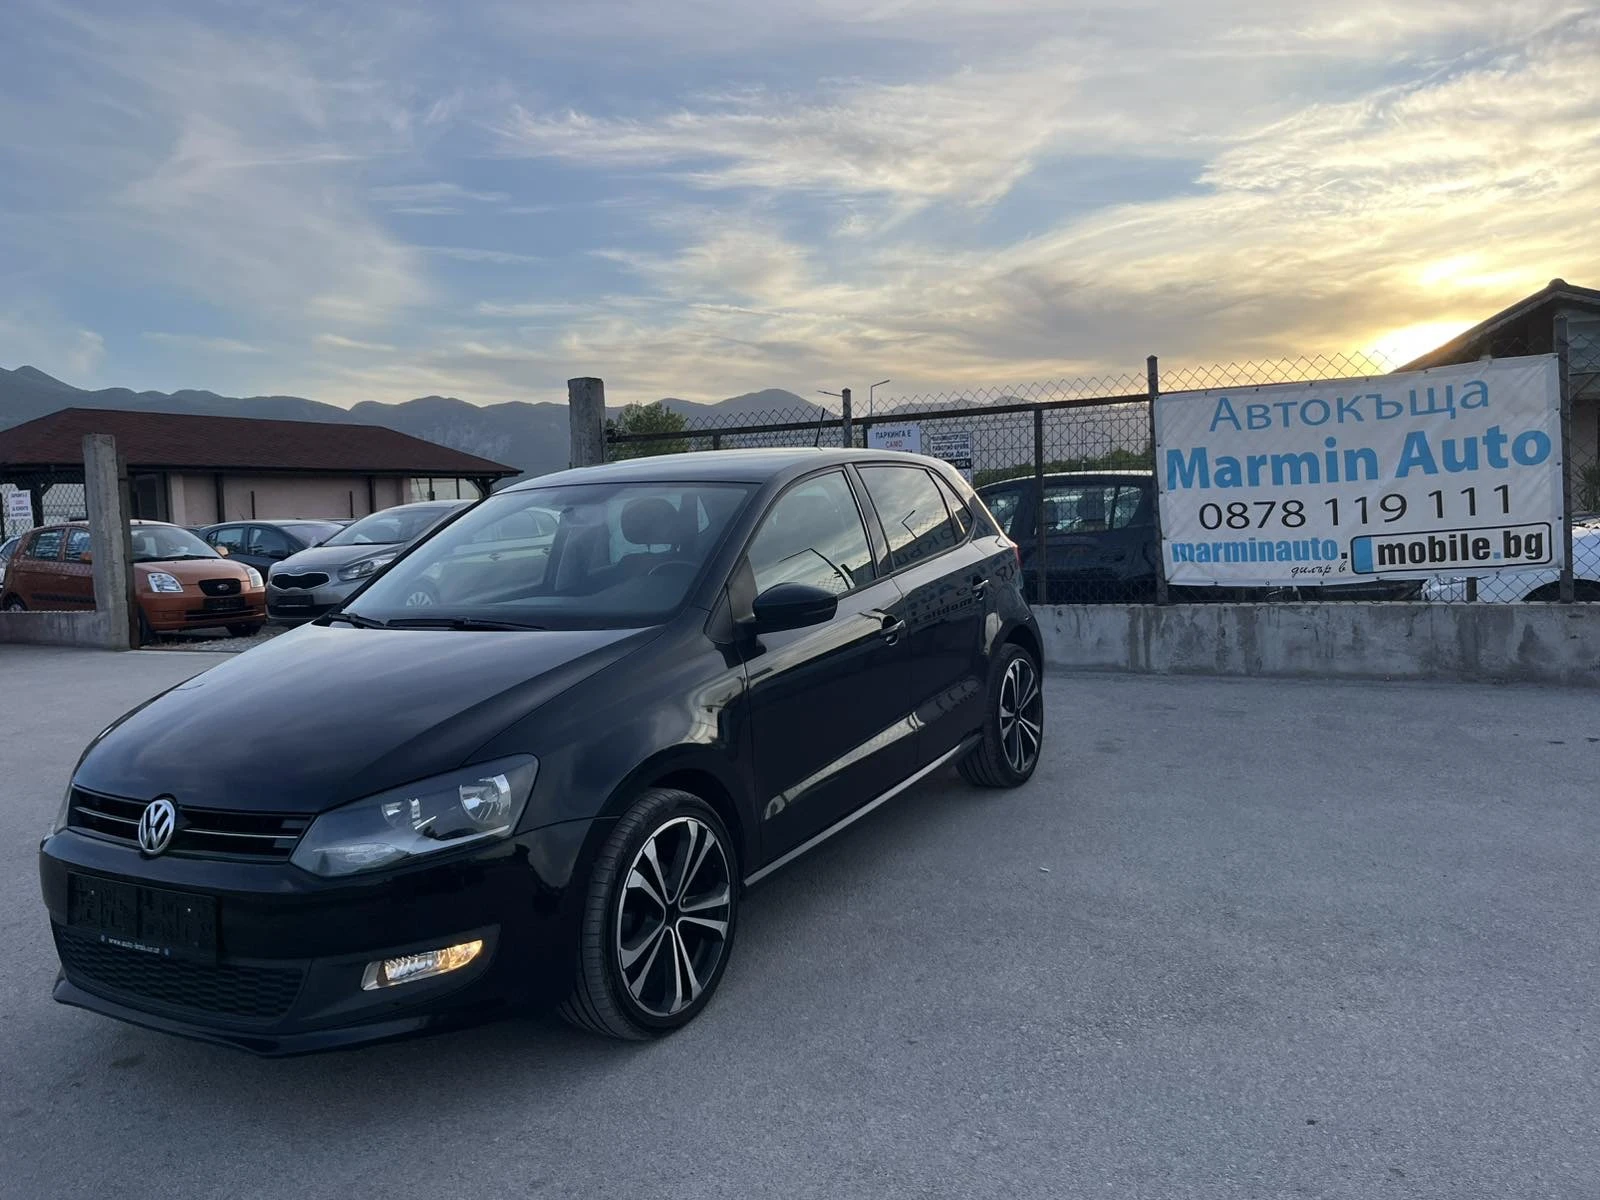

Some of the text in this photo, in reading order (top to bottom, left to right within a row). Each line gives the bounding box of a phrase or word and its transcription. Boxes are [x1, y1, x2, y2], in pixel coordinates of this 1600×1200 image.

[1209, 379, 1490, 432] Автокъща
[1166, 425, 1552, 491] Marmin Auto
[1199, 484, 1511, 530] 0878 119 111
[1377, 529, 1543, 566] mobile.bg
